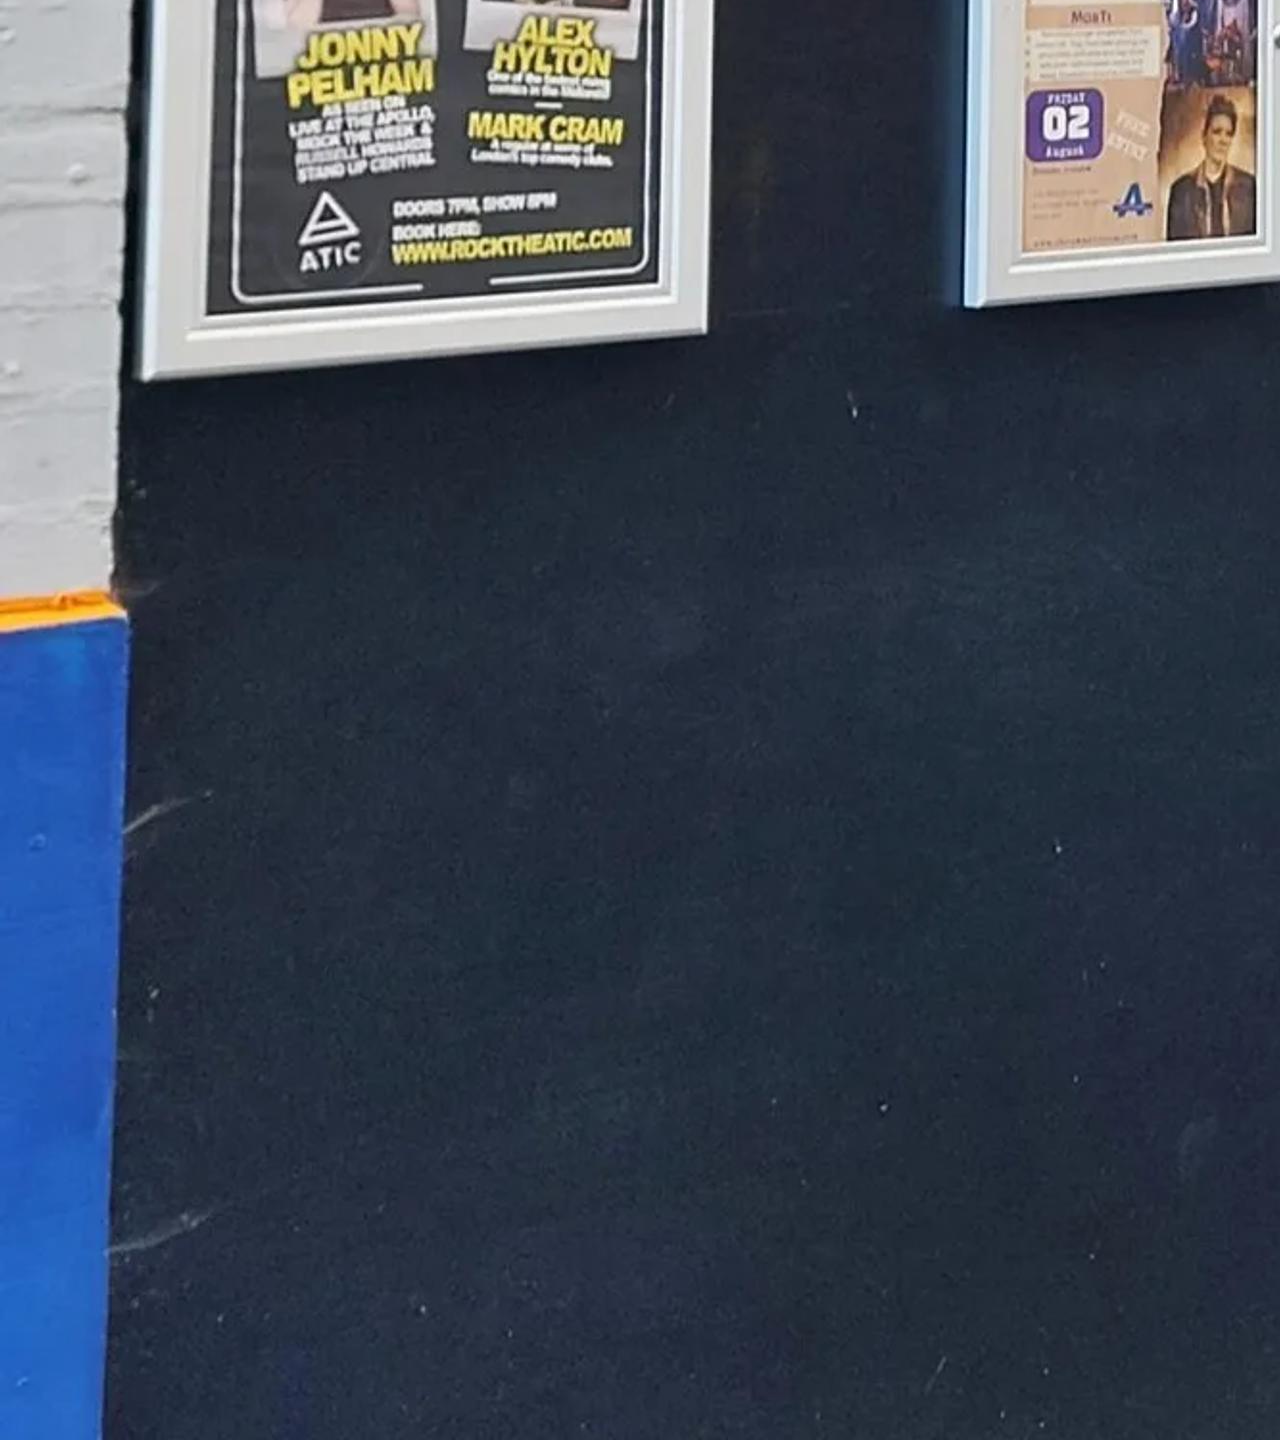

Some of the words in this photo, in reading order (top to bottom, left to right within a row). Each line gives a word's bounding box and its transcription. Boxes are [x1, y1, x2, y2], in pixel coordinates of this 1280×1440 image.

[298, 22, 422, 68] JONNY
[517, 15, 595, 48] ALEX
[493, 42, 612, 77] HYLTON
[288, 58, 434, 108] PELHAM
[468, 111, 546, 140] MARK
[549, 115, 624, 145] CRAM
[1042, 105, 1090, 141] 02
[393, 199, 444, 218] DOORS
[482, 194, 526, 213] SHOW
[391, 227, 634, 265] WWW.ROCKTHEATIC.COM
[392, 223, 436, 241] BOOK
[299, 241, 362, 272] ATIC
